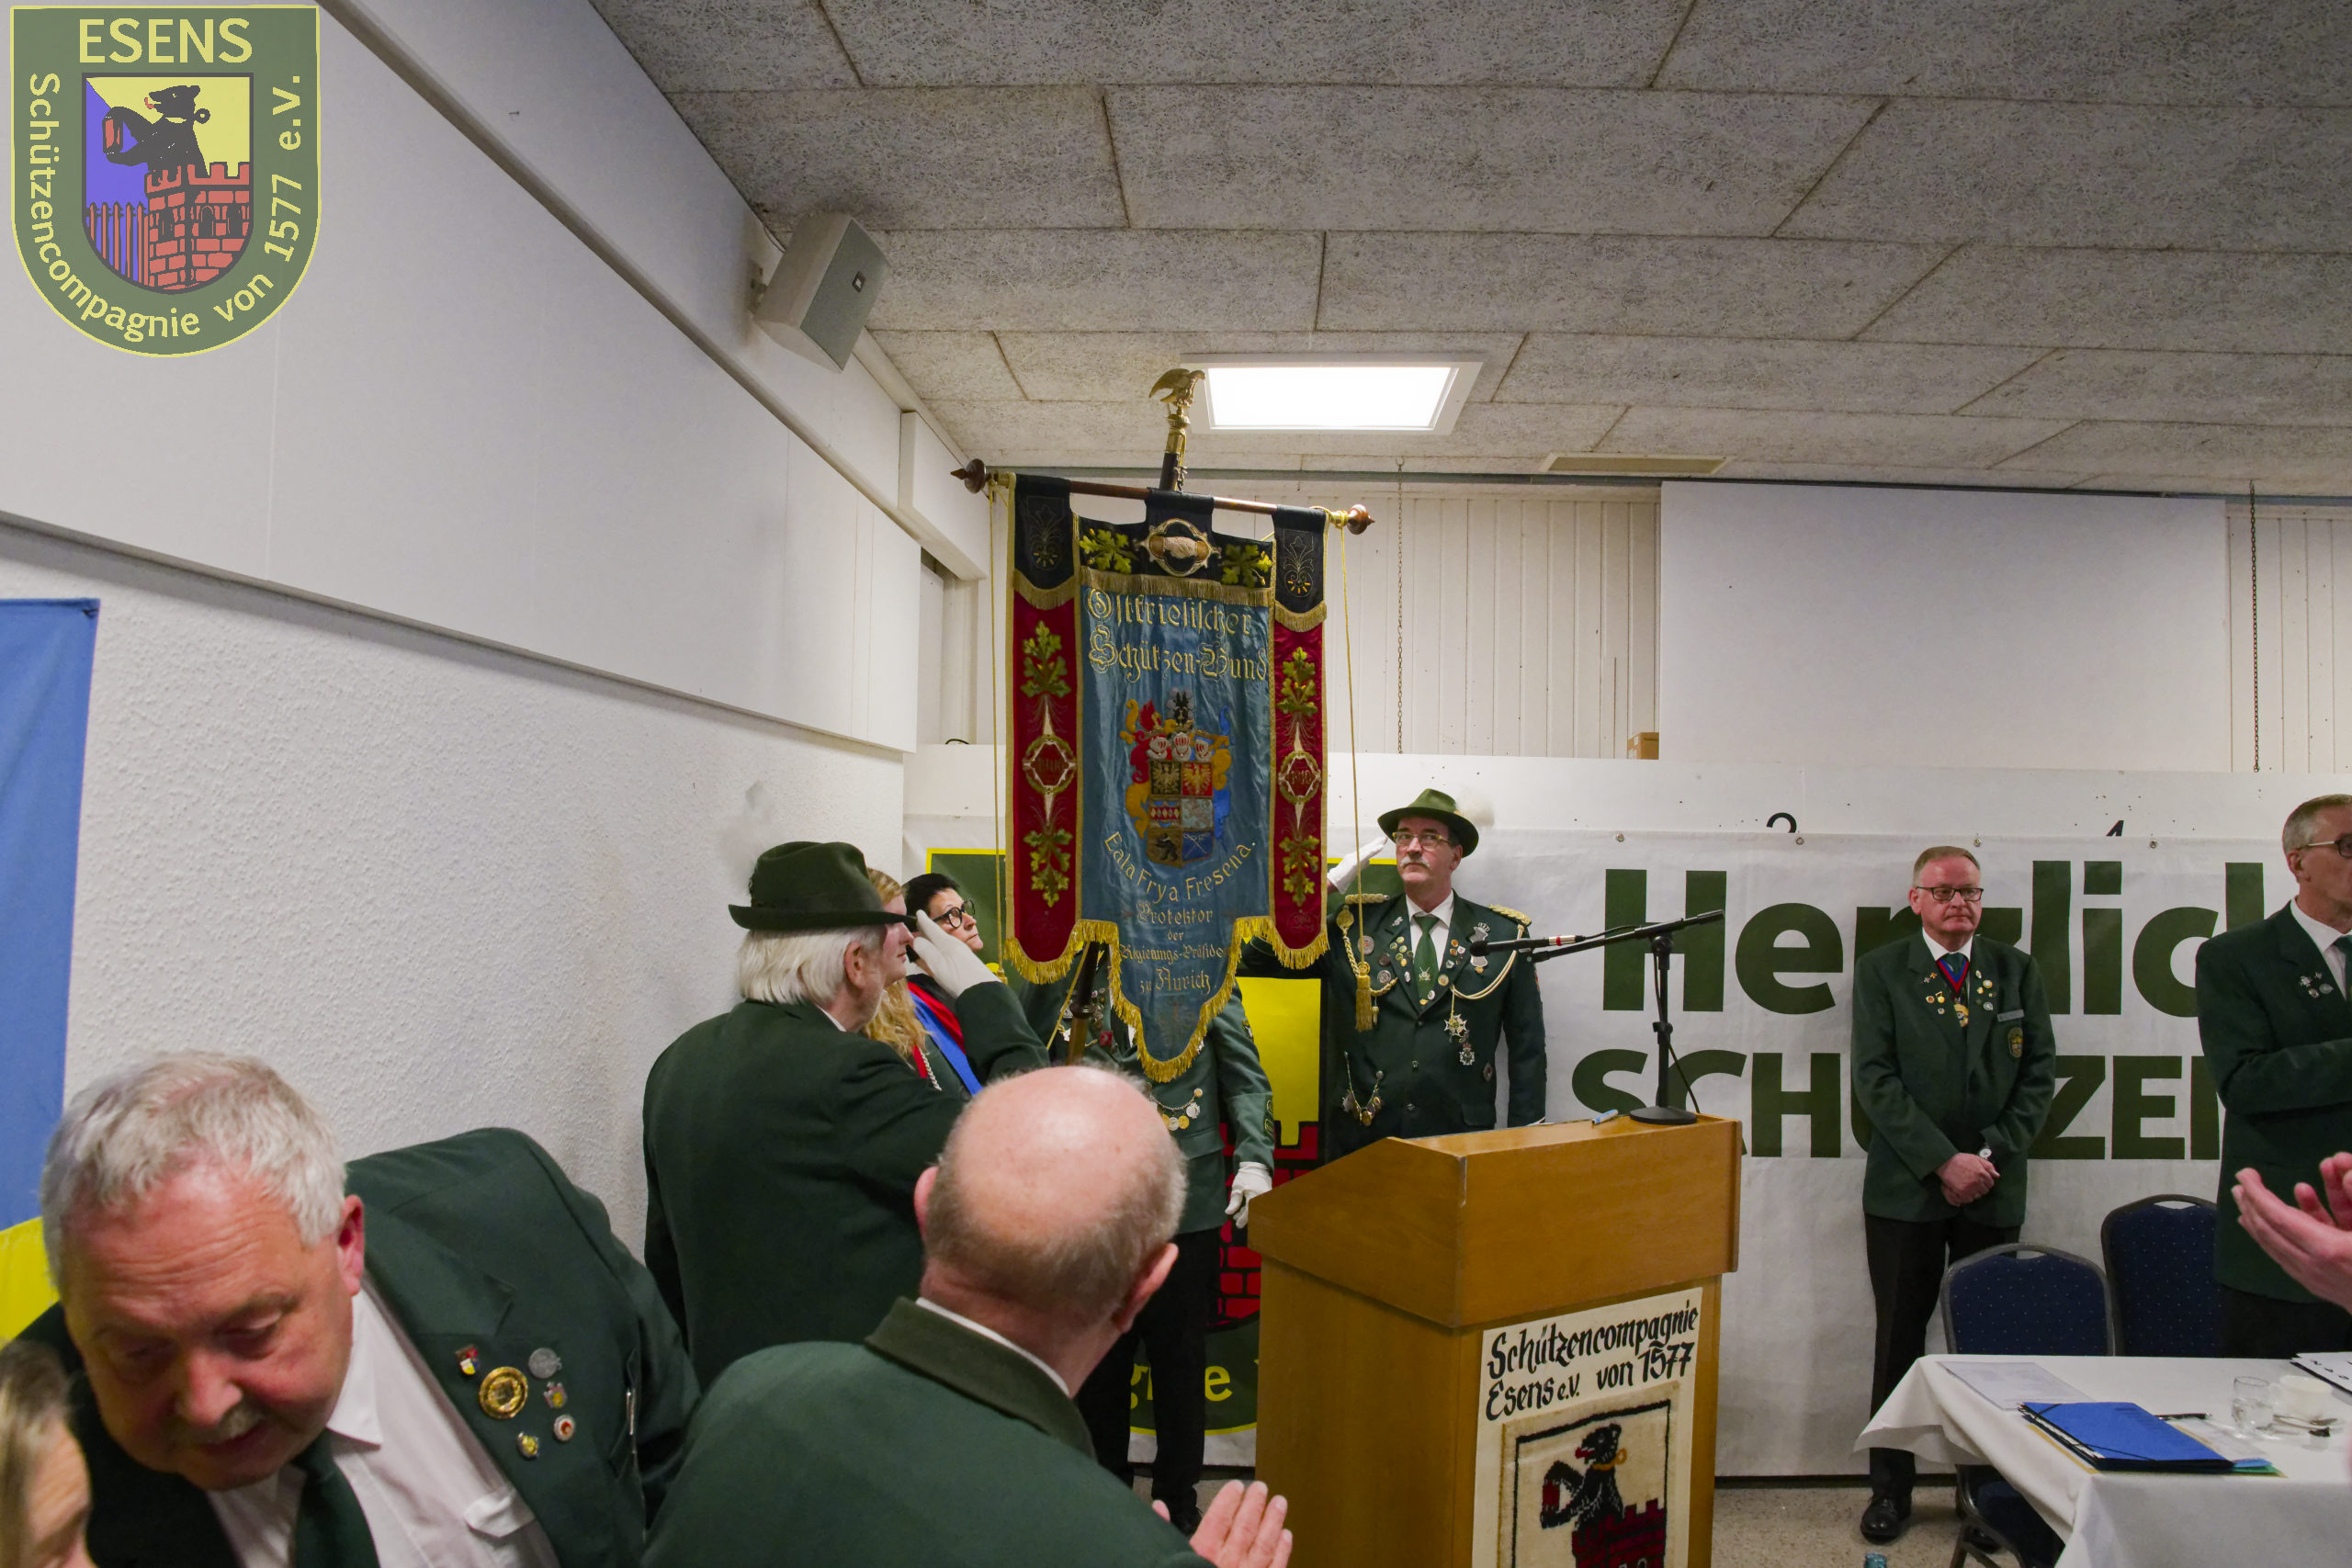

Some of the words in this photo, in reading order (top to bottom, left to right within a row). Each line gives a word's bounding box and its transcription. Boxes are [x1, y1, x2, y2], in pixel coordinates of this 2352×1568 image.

[1104, 831, 1136, 880] Eala
[1137, 868, 1178, 904] Frya
[1136, 903, 1213, 925] Protektor
[1167, 930, 1184, 942] der
[1602, 858, 2266, 1017] Herlic
[1120, 943, 1227, 965] Regierungs-Präside
[1140, 980, 1152, 993] zu
[1572, 1048, 2221, 1160] SCHZE
[1487, 1299, 1699, 1379] Schützencompagnie
[1486, 1378, 1554, 1421] Esens
[1557, 1372, 1580, 1400] e.V.
[1597, 1361, 1634, 1391] von
[1638, 1342, 1695, 1383] 1577
